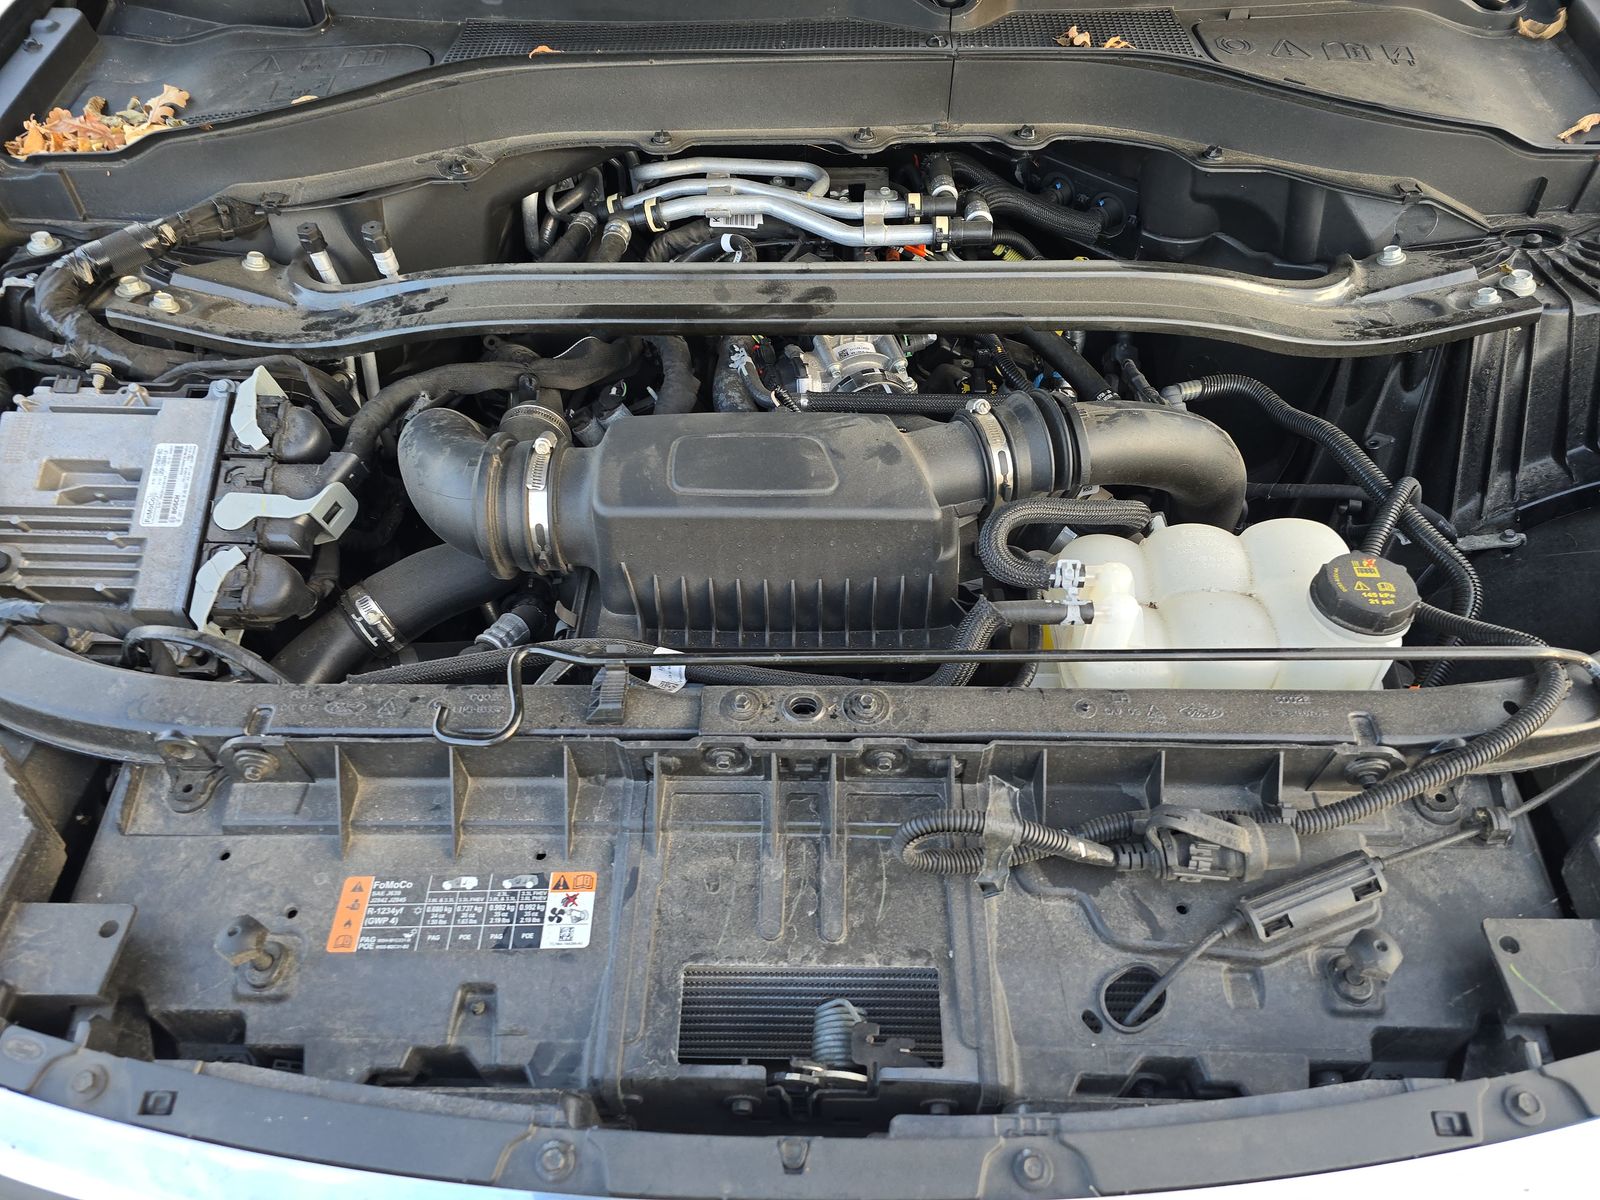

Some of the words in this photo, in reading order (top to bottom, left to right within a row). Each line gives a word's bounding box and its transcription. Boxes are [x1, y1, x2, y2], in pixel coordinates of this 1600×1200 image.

[171, 495, 180, 514] BOSCH
[144, 497, 157, 523] FoMoCo
[373, 881, 413, 889] FoMoCo
[367, 907, 404, 916] R-1234yf
[365, 917, 389, 926] (GWP
[389, 917, 399, 925] 4)
